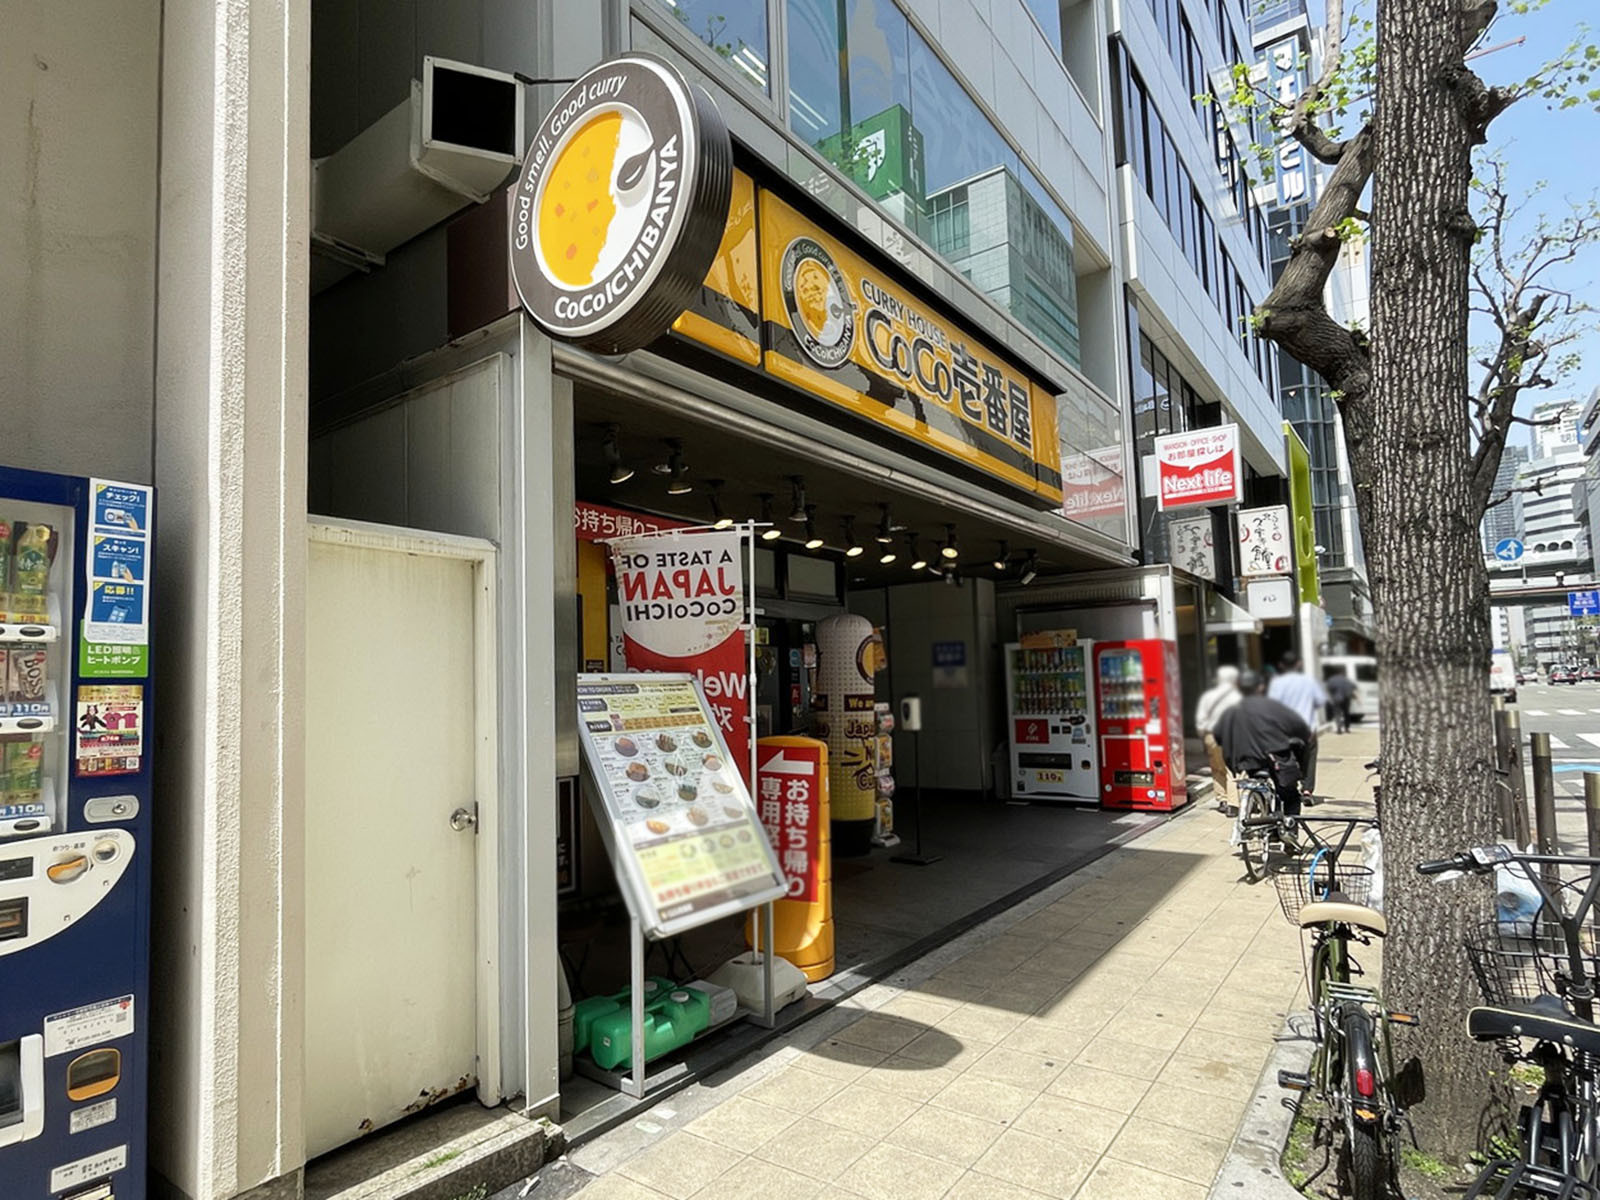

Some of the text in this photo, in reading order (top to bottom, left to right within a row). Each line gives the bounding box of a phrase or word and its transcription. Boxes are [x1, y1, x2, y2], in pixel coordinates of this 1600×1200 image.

[515, 74, 628, 250] Good smell. Good curry
[861, 279, 948, 350] CURRY HOUSE
[1163, 473, 1203, 494] Next
[1203, 467, 1233, 488] life
[24, 660, 43, 696] BOSS
[87, 656, 141, 665] ヒートポンプ
[784, 779, 810, 897] お持ち帰り
